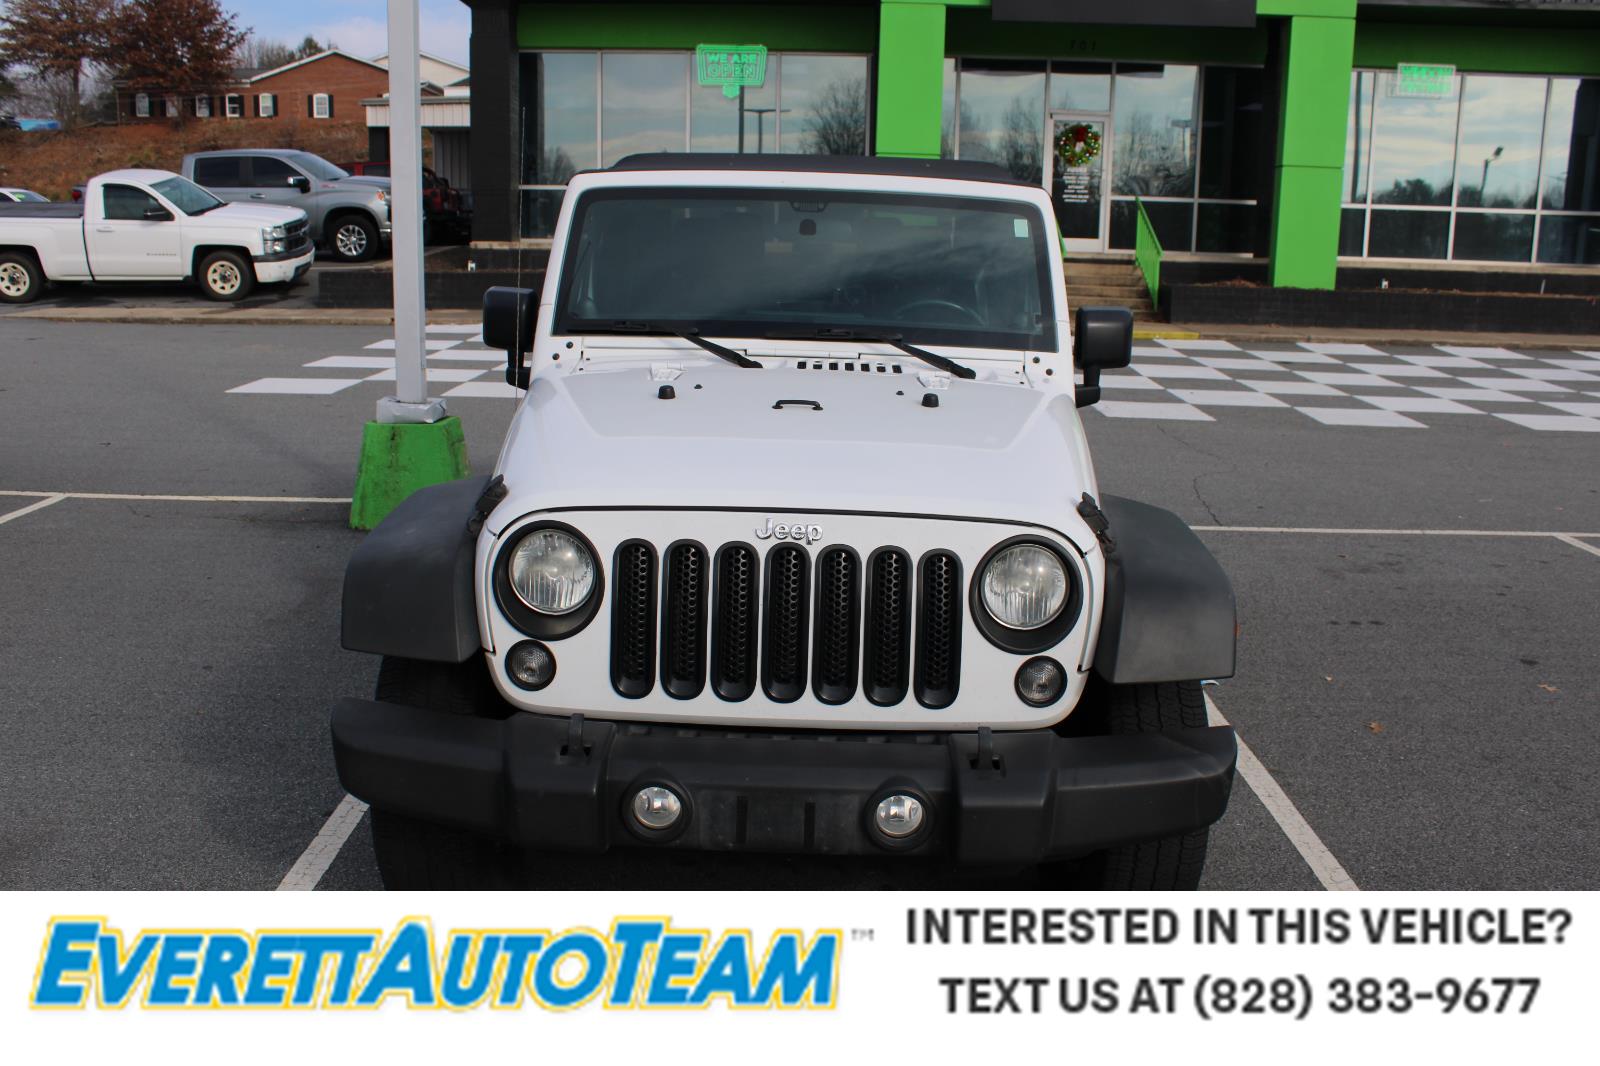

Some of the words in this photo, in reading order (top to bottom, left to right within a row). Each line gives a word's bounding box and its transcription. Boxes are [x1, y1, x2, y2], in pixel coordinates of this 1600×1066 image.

[707, 52, 728, 63] WE
[732, 52, 757, 64] ARE
[707, 63, 755, 78] OPEN
[755, 517, 823, 546] Jeep
